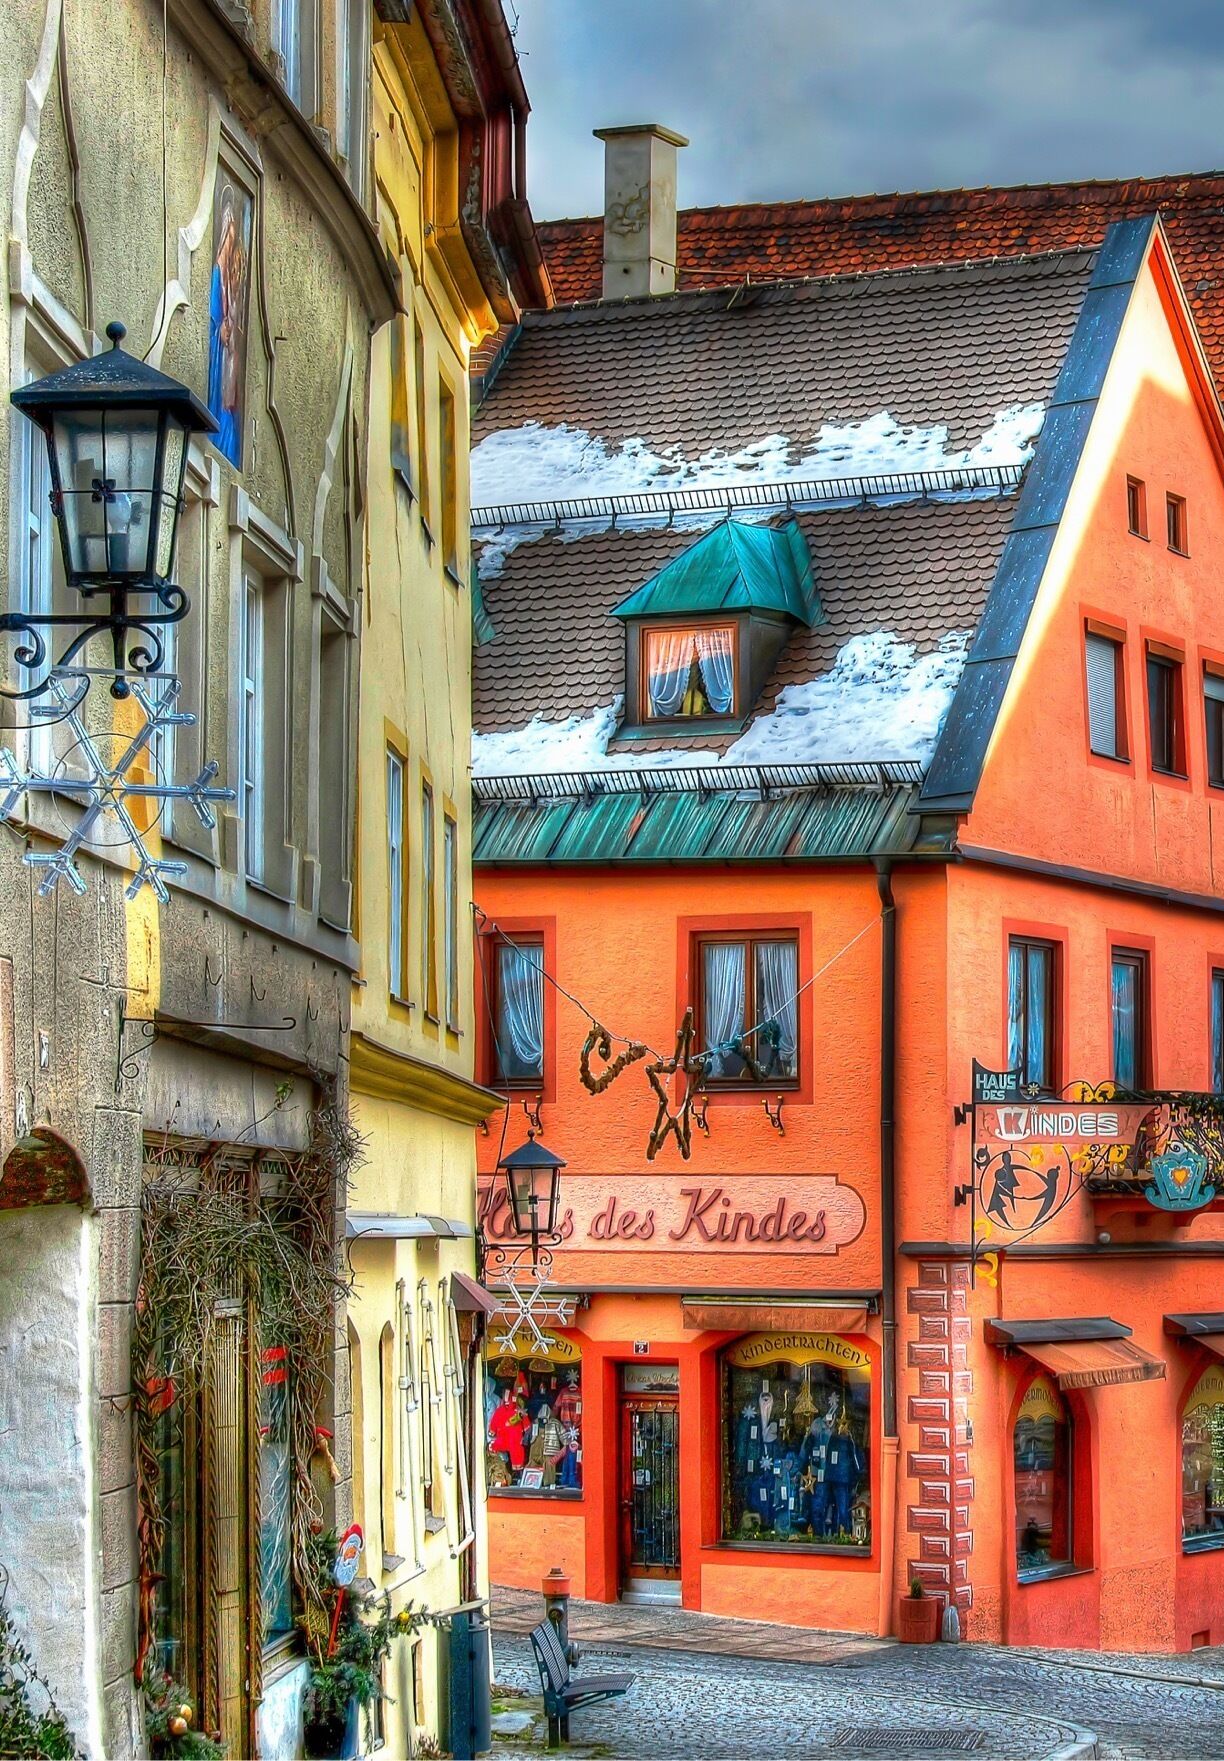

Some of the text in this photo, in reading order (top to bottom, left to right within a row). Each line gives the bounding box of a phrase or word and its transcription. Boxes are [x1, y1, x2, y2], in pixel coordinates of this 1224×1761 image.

[975, 1073, 1017, 1090] HAUS
[982, 1090, 1006, 1101] DES
[586, 1196, 656, 1240] des
[668, 1188, 826, 1243] Kindes
